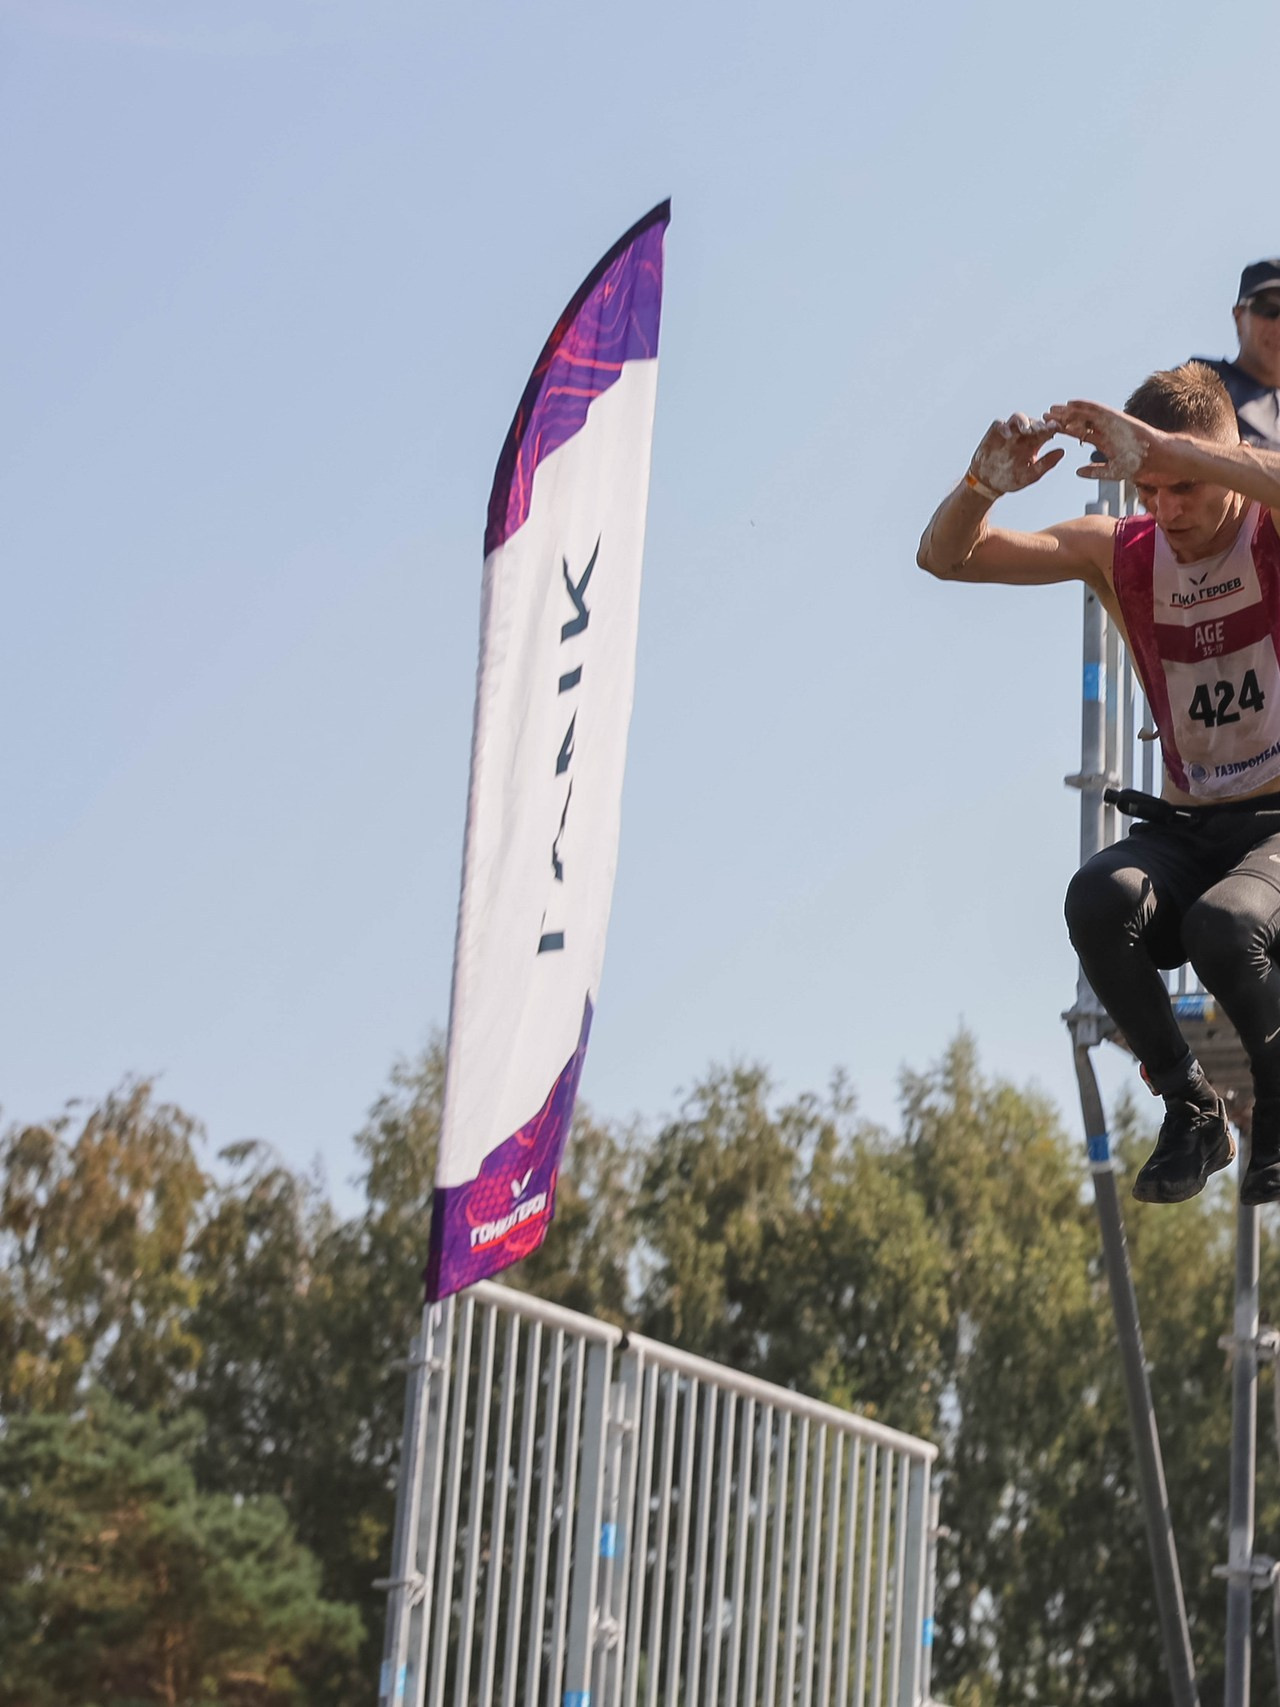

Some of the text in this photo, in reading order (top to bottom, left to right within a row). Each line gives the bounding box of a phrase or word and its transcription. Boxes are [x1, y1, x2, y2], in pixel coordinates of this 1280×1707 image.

[1171, 577, 1242, 606] ГКА ГЕРОЕВ
[1195, 621, 1225, 649] AGE
[1188, 669, 1265, 728] 424
